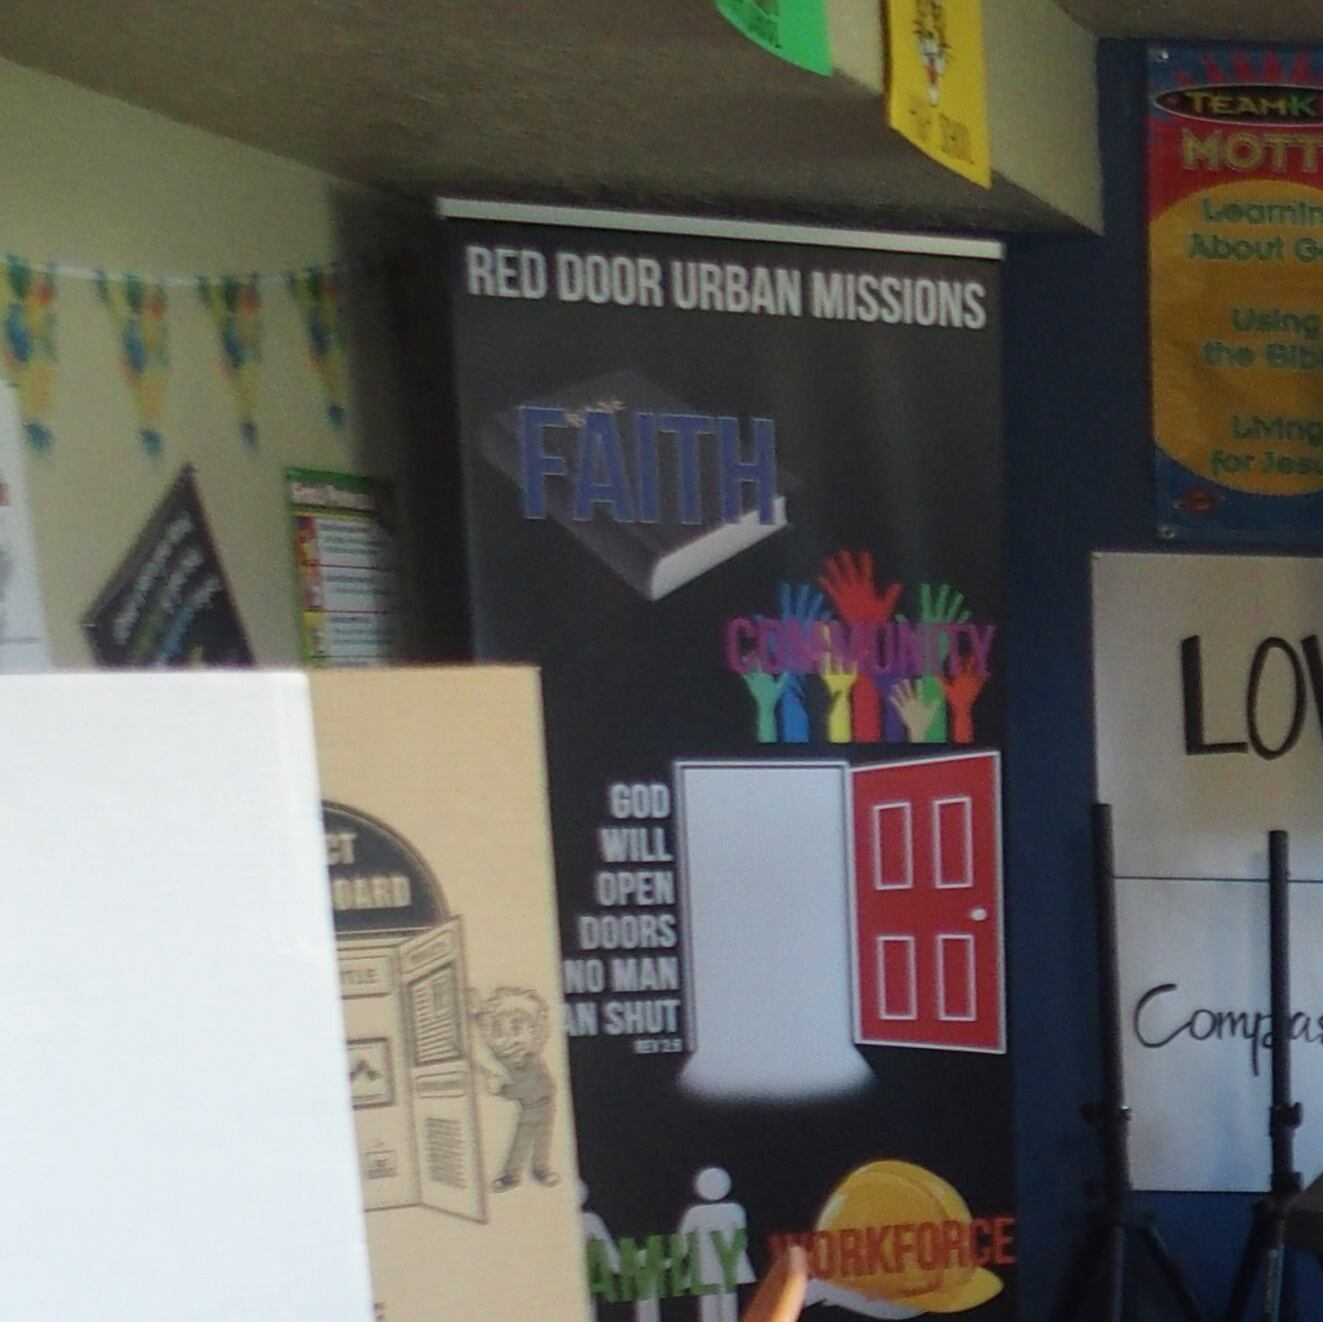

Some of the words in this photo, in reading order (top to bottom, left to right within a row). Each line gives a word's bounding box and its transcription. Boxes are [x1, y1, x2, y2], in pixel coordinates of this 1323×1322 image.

[1187, 235, 1284, 263] About
[465, 245, 547, 299] RED
[557, 251, 664, 307] DOOR
[670, 261, 802, 316] URBAN
[810, 270, 987, 330] MISSIONS
[1231, 308, 1321, 339] Using
[1202, 340, 1256, 369] the
[517, 405, 779, 526] FAITH
[1209, 449, 1253, 478] for
[724, 616, 996, 677] COMMUNITY
[609, 782, 670, 819] GOD
[600, 828, 673, 863] WILL
[334, 876, 411, 911] OARD
[598, 871, 674, 907] OPEN
[577, 915, 677, 951] DOORS
[564, 958, 604, 995] NO
[612, 957, 678, 993] MAN
[564, 1002, 598, 1036] AN
[606, 1000, 680, 1036] SHUT
[587, 1227, 747, 1303] AMILY
[767, 1216, 1016, 1281] WORKFORCE
